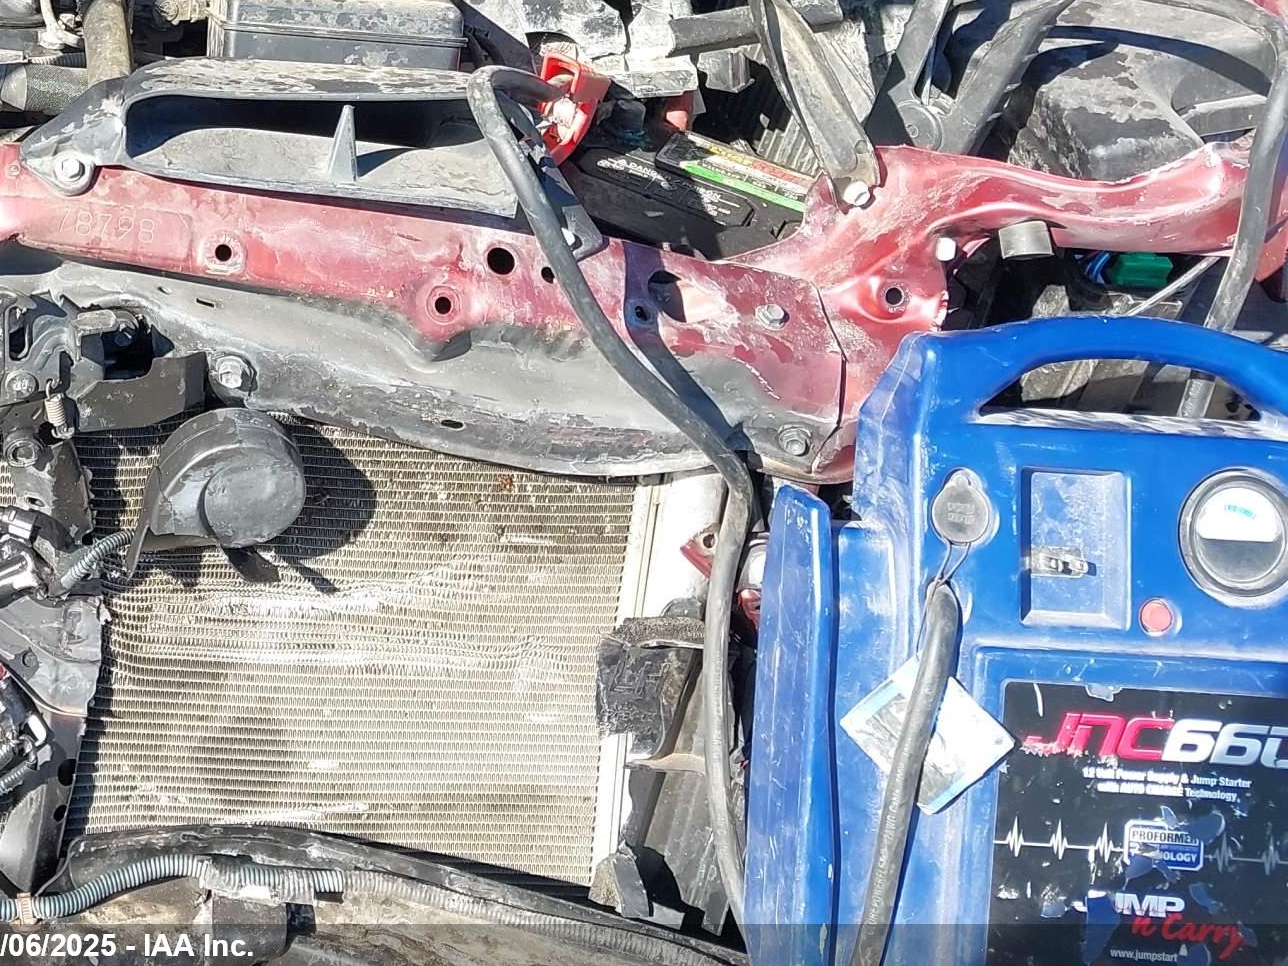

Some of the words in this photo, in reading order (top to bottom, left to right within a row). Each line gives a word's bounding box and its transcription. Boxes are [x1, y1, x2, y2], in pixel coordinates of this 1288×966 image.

[1190, 774, 1218, 788] Jump
[1218, 776, 1252, 788] Starter
[1161, 913, 1243, 961] Carry
